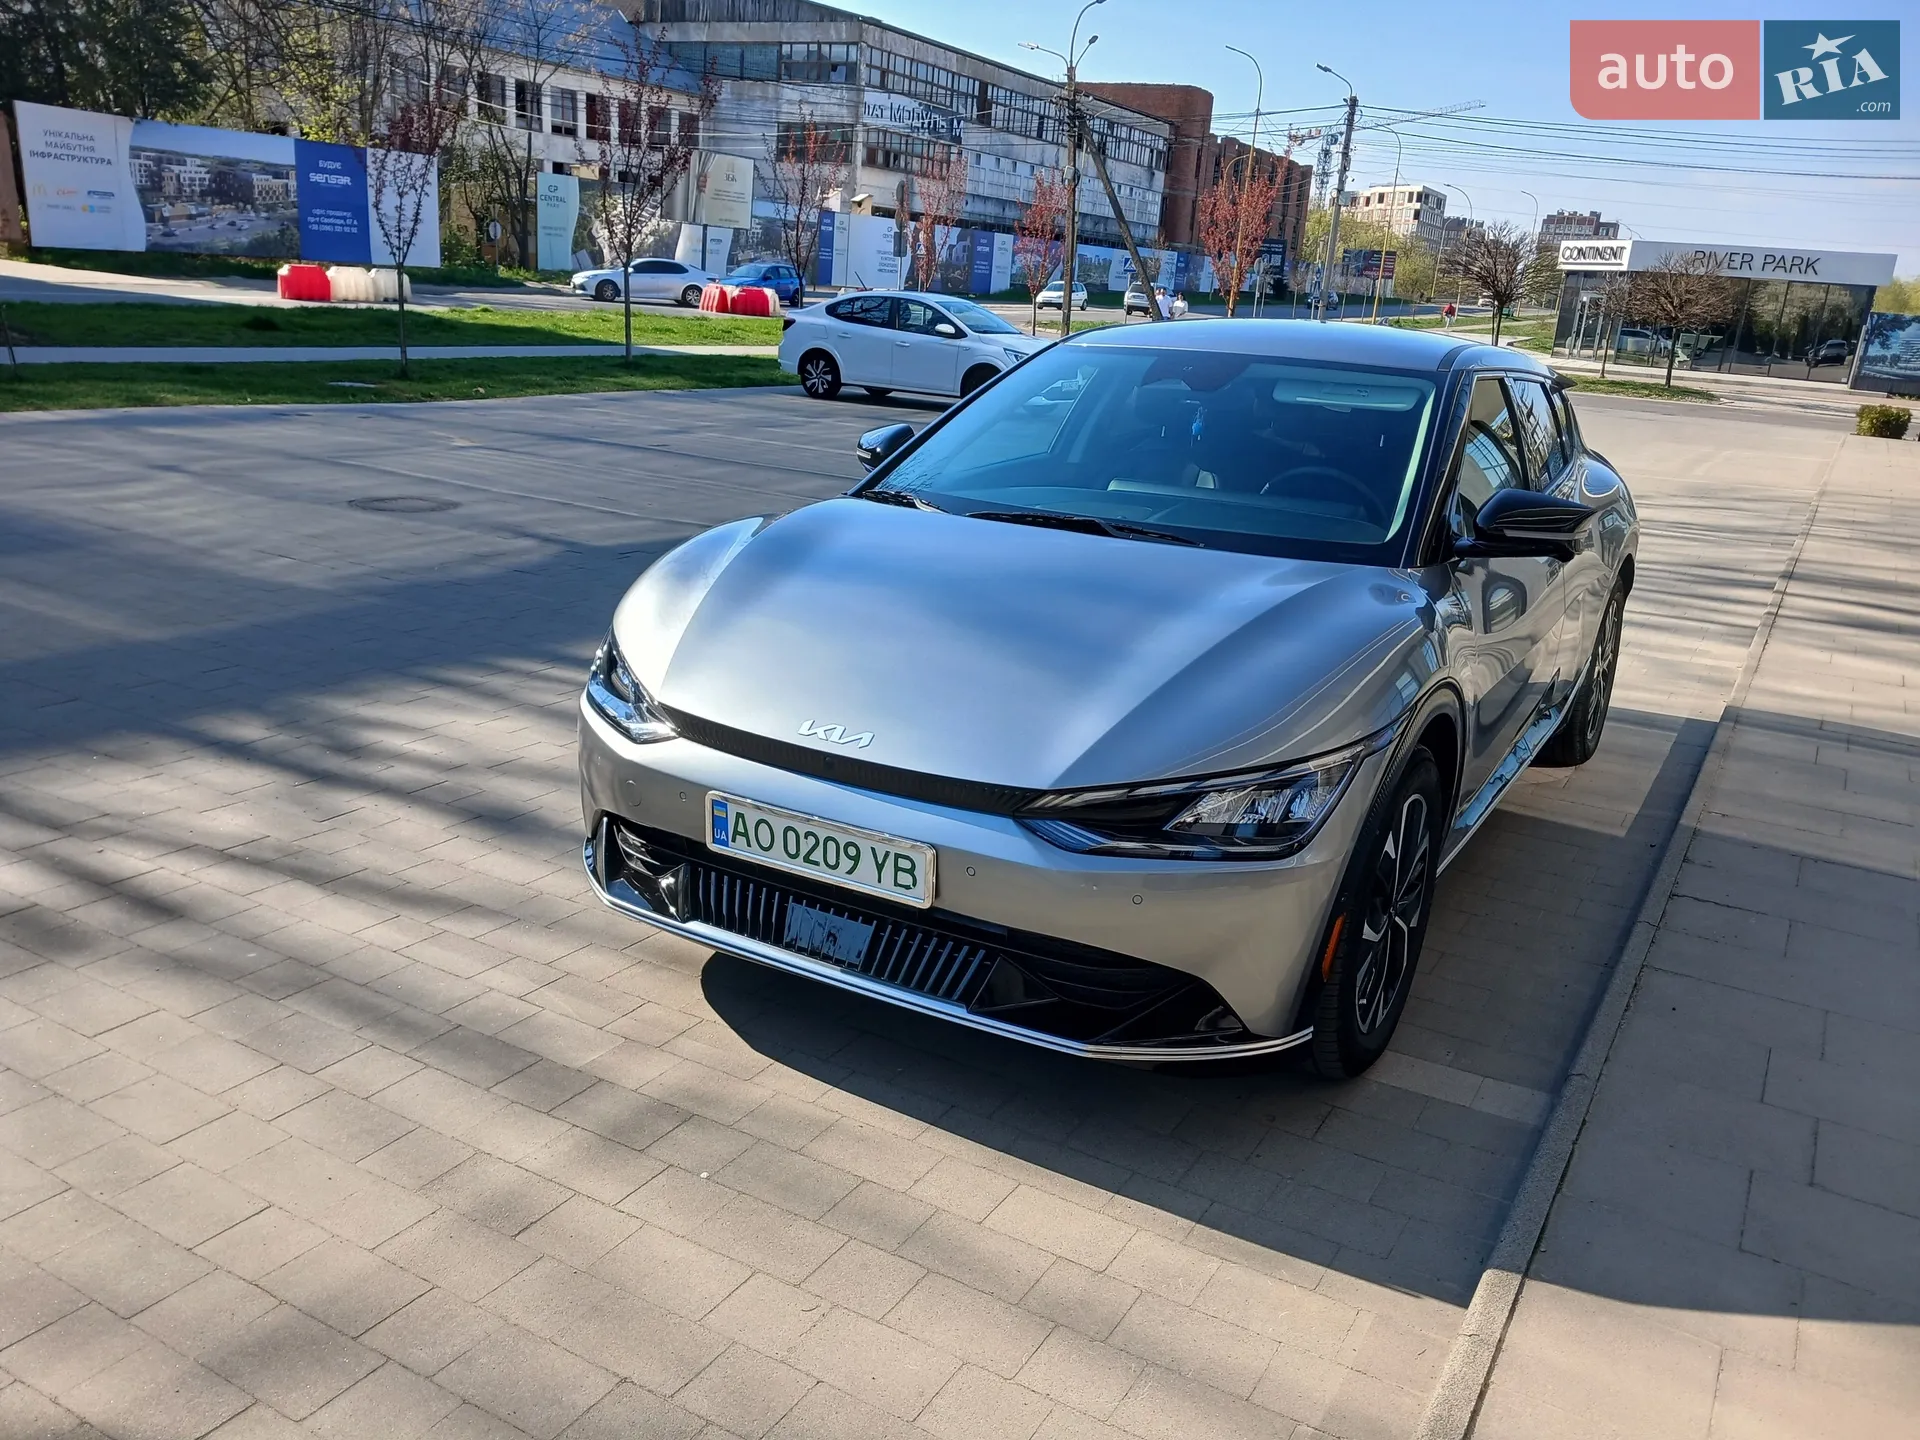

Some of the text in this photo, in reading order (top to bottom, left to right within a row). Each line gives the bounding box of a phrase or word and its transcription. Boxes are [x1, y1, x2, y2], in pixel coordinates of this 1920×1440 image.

[43, 129, 95, 142] УНІКАЛЬНА
[45, 141, 95, 153] МАЙБУТНЯ
[29, 150, 112, 166] ІНФРАСТРУКТУРА
[319, 160, 342, 169] БУДУЄ
[540, 194, 566, 203] CENTRAL
[1562, 246, 1626, 261] CONTINENT
[1692, 250, 1821, 275] RIVER PARK
[798, 719, 875, 749] KIA
[714, 827, 727, 842] UA
[731, 811, 918, 890] AO 0209 YB
